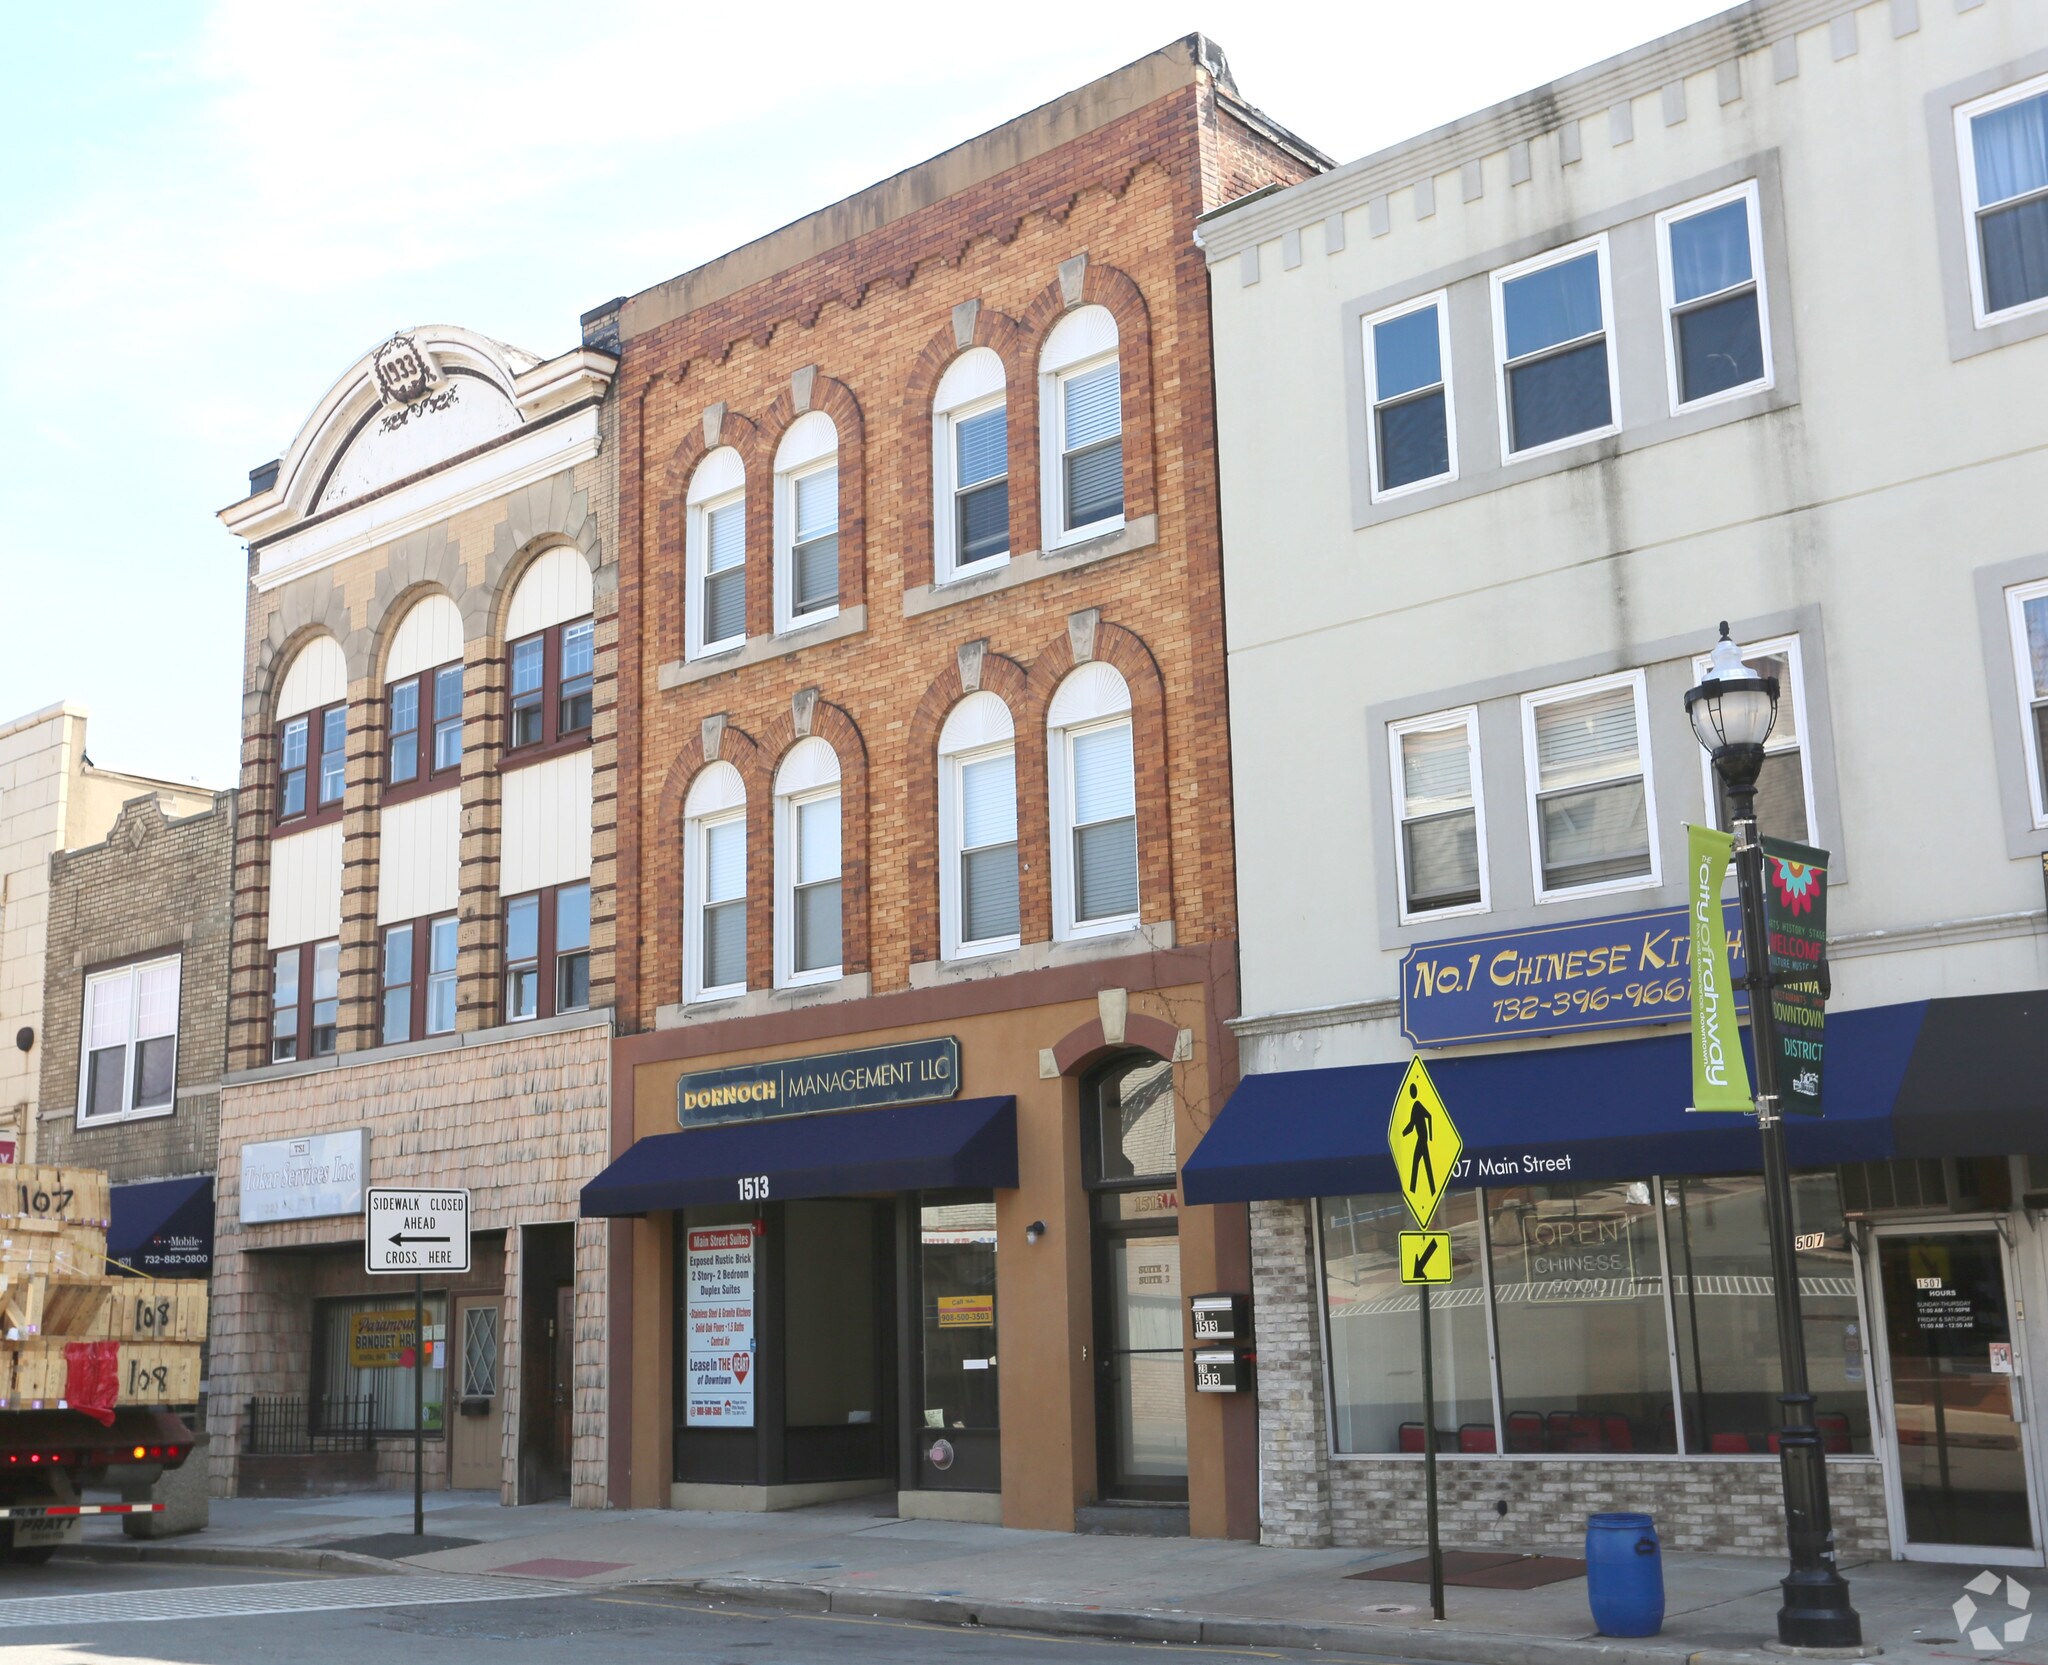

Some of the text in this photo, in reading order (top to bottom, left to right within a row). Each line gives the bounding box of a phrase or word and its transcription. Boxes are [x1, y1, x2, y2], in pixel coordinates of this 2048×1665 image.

[382, 354, 418, 385] 1933
[1702, 855, 1712, 864] THE
[1782, 923, 1806, 936] HISTORY
[1809, 928, 1825, 940] STAGE
[1770, 931, 1822, 961] WELCOME
[1490, 945, 1631, 985] CHINESE
[1493, 978, 1691, 1023] 732-396-966
[1700, 1012, 1709, 1067] downtown.
[1784, 1038, 1823, 1061] DISTRICT
[684, 1056, 949, 1111] DORNOCH MANAGEMENT LLC
[294, 1145, 305, 1153] TSI
[1478, 1157, 1519, 1176] Main
[1523, 1154, 1571, 1173] Street
[245, 1155, 356, 1191] Tokar Services Inc.
[738, 1175, 770, 1200] 1513
[22, 1185, 74, 1214] 107
[373, 1197, 464, 1211] SIDEWALK CLOSED
[403, 1216, 436, 1230] AHEAD
[693, 1233, 749, 1248] Main Street Suites
[1535, 1221, 1618, 1246] OPEN
[144, 1254, 208, 1264] 732-882-0800
[386, 1250, 452, 1264] CROSS HERE
[690, 1253, 752, 1268] Exposed Rustic Brick
[1534, 1254, 1623, 1274] CHINESE
[692, 1271, 696, 1281] 2
[717, 1269, 722, 1280] 2
[723, 1268, 749, 1279] Bedroom
[1139, 1264, 1170, 1274] SUITE 2
[1139, 1275, 1170, 1285] SUITE 3
[1918, 1279, 1940, 1288] 1507
[701, 1284, 741, 1297] Duplex Suites
[135, 1300, 170, 1331] 108
[941, 1313, 989, 1321] 908-500-3503
[358, 1316, 416, 1334] Paramoun
[1196, 1321, 1217, 1332] 1513
[356, 1332, 416, 1349] BANQUET HAL
[690, 1359, 710, 1371] Lease
[718, 1358, 731, 1371] THE
[733, 1357, 749, 1372] HEART
[130, 1360, 167, 1394] 108
[697, 1375, 732, 1385] of Downtown
[1199, 1374, 1220, 1385] 1513
[20, 1518, 76, 1532] PRATT
